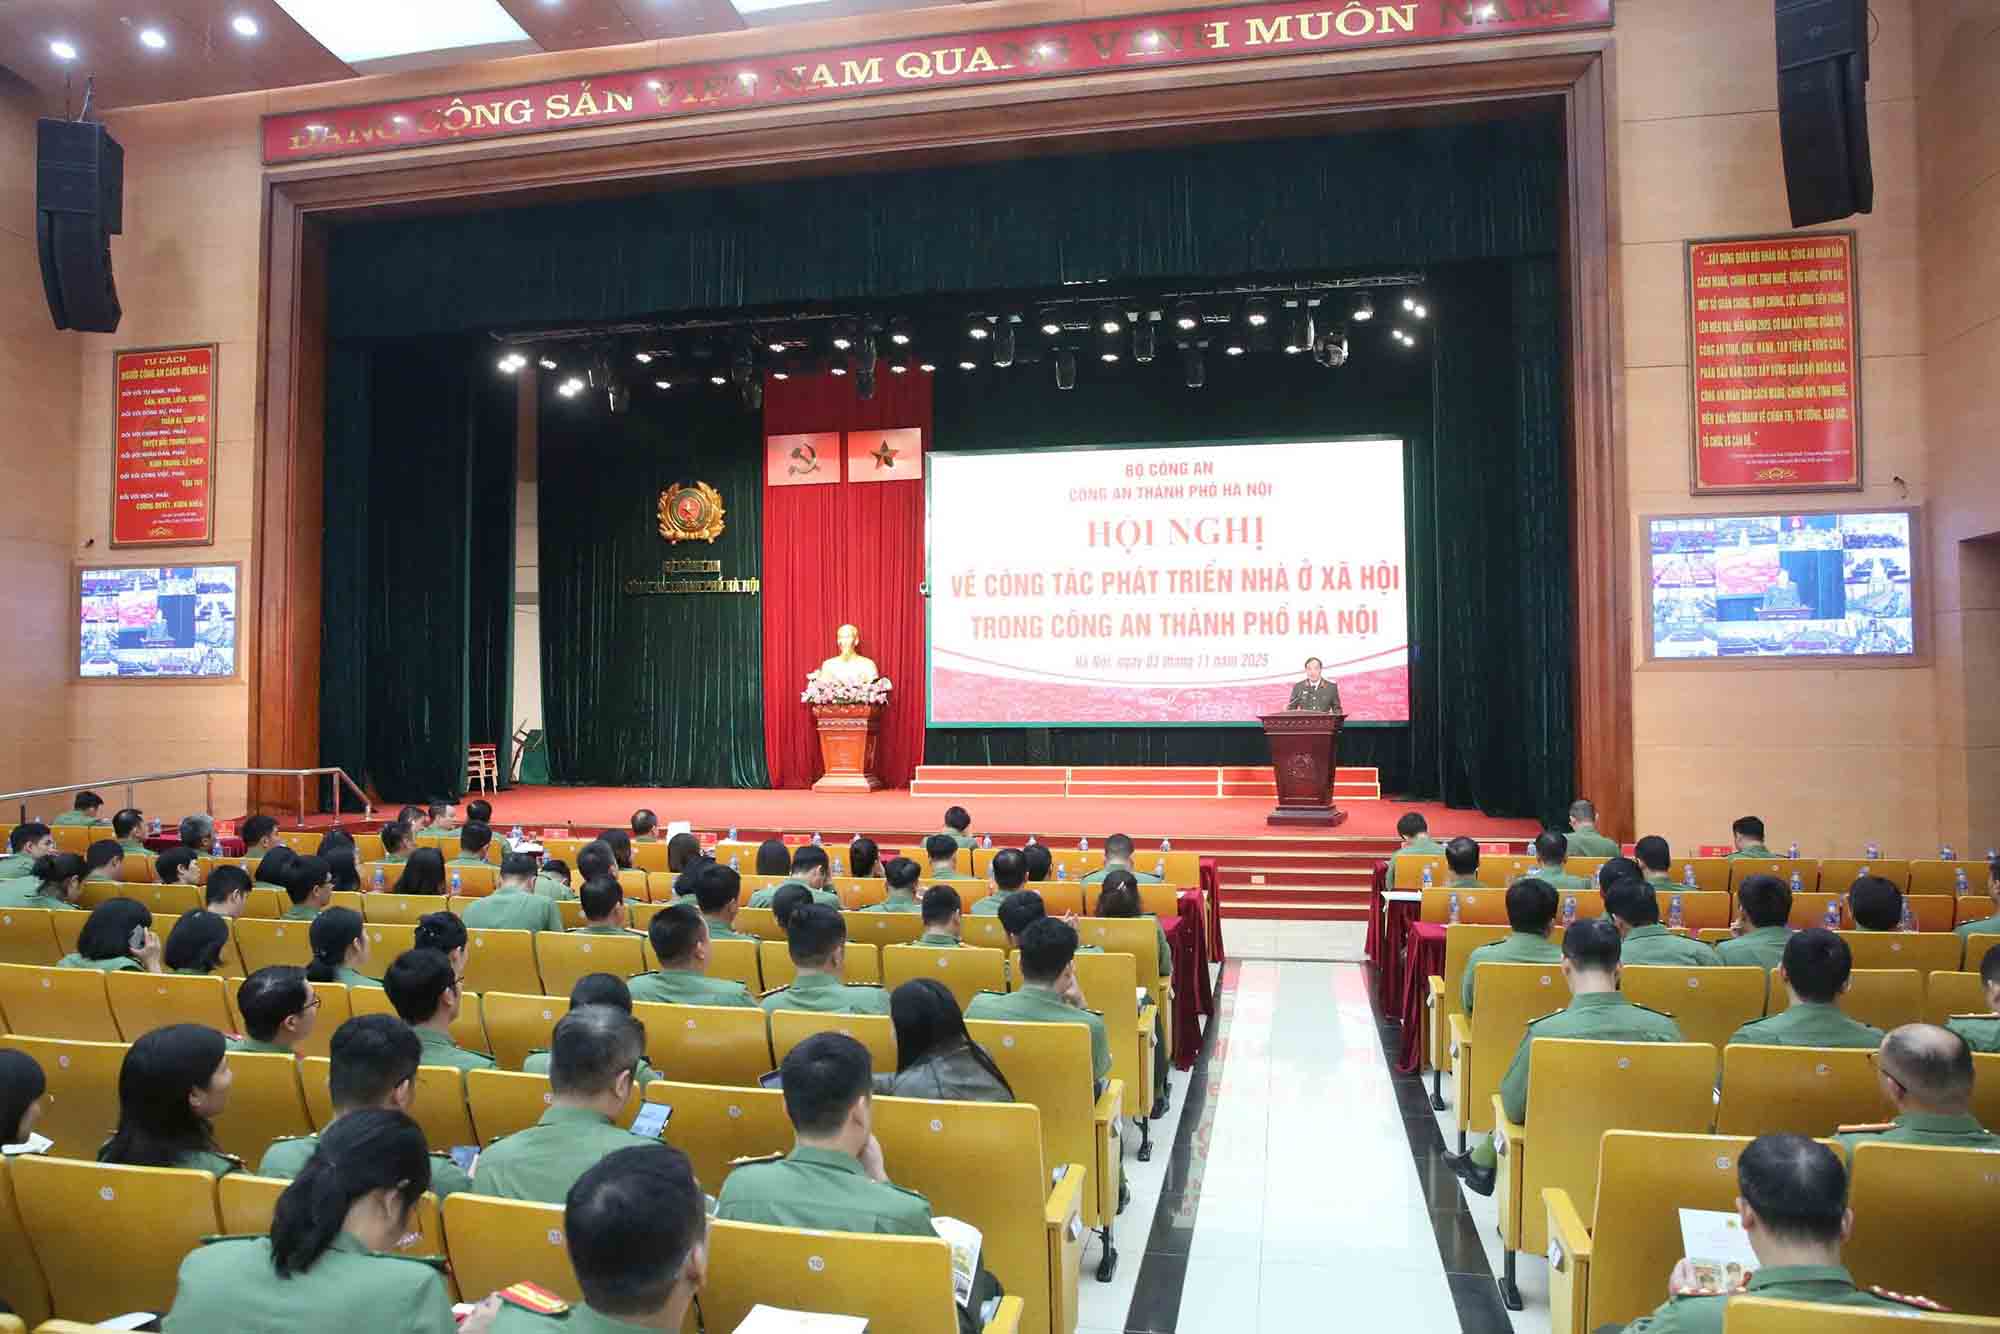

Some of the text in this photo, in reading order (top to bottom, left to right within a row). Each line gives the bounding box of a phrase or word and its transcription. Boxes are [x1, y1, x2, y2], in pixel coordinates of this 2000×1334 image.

[416, 98, 534, 136] CỘNG
[545, 80, 633, 120] SẢN
[774, 57, 880, 93] NAM
[1245, 1, 1416, 46] MUÔN
[1149, 460, 1189, 477] CÔNG
[1193, 461, 1214, 475] AN
[1112, 487, 1132, 500] AN
[1088, 514, 1264, 554] HỘI NGHỊ
[984, 567, 1044, 597] CÔNG
[1051, 566, 1094, 596] TÁC
[1101, 564, 1160, 596] PHÁT
[1167, 559, 1233, 594] TRIỂN
[1241, 561, 1289, 592] NHÀ
[1321, 560, 1353, 591] XÃ
[1360, 559, 1400, 596] HỘI
[970, 602, 1379, 640] TRONG CÔNG AN THÀNH PHỐ HÀ NỘI
[1240, 652, 1269, 668] 2025
